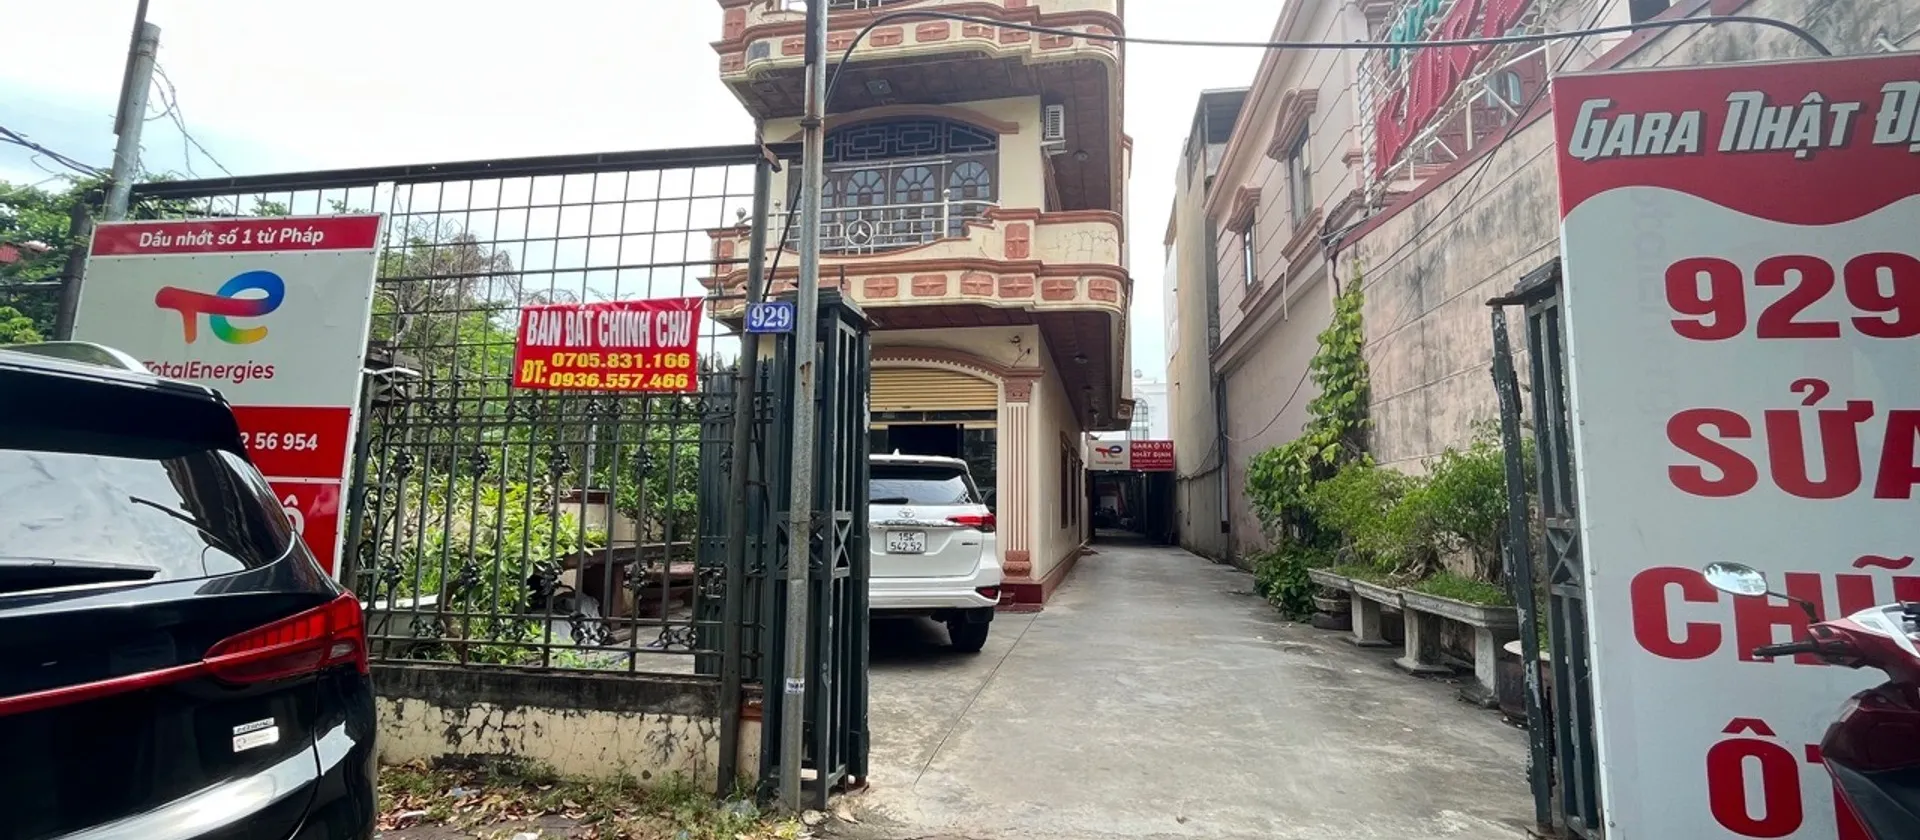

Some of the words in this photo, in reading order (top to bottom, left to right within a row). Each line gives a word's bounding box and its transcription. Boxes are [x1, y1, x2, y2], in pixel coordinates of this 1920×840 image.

[1568, 98, 1701, 161] GARA
[1718, 90, 1861, 158] NHẬT
[139, 230, 172, 247] Dầu
[175, 230, 213, 246] nhớt
[217, 226, 239, 244] số
[241, 229, 252, 244] 1
[257, 226, 277, 243] từ
[279, 226, 324, 245] Pháp
[1664, 252, 1920, 341] 929
[526, 305, 562, 346] BÁN
[564, 304, 594, 347] ĐẤT
[598, 304, 652, 347] CHÍNH
[655, 299, 693, 348] CHỦ
[751, 304, 791, 328] 929
[551, 352, 690, 369] 0705.831.166
[521, 359, 548, 384] ĐT:
[549, 372, 689, 388] 0936.557.466
[254, 432, 279, 450] 56
[282, 433, 318, 451] 954
[898, 532, 915, 541] 15K
